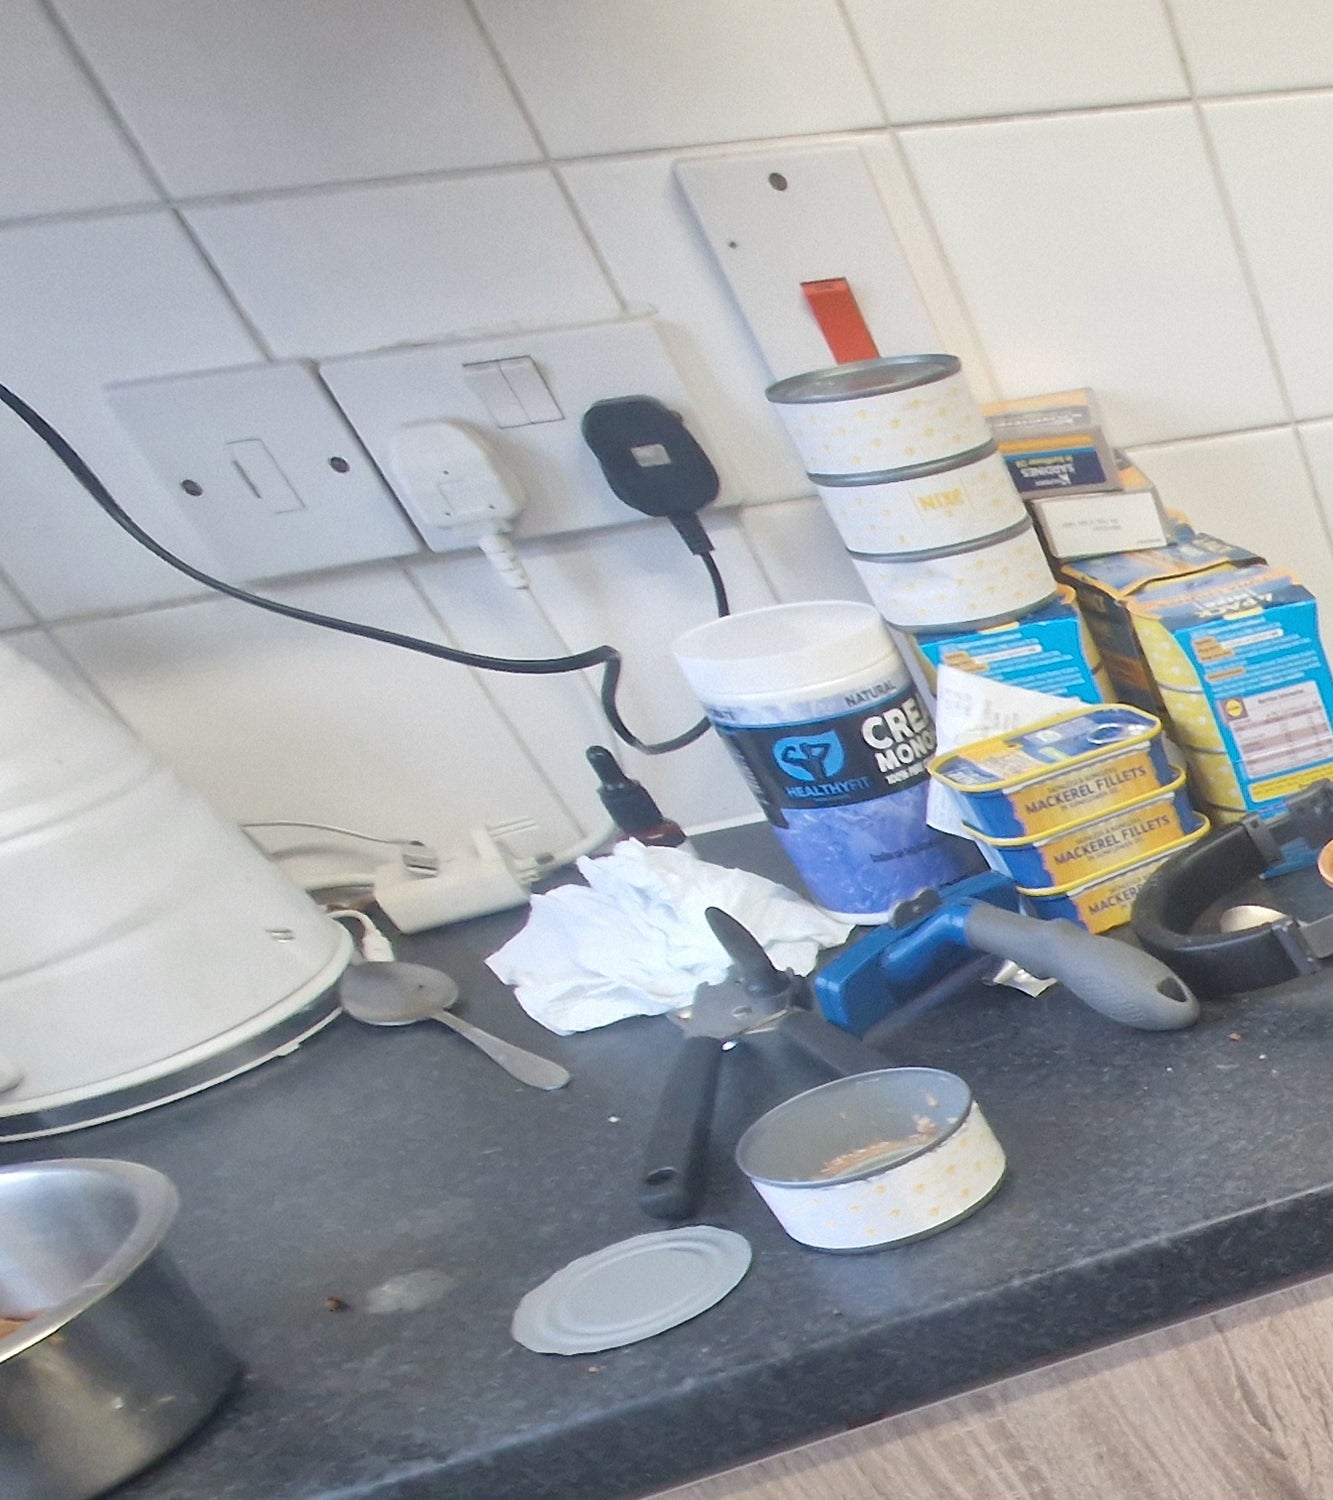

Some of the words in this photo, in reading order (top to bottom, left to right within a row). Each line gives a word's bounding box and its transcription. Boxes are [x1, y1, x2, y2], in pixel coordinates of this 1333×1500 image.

[845, 680, 896, 707] NATURAL
[785, 777, 870, 799] HEALTHYFIT
[1026, 782, 1096, 815] MACKEREL
[1097, 766, 1147, 790] FILLETS
[1054, 833, 1119, 865] MACKEREL
[1121, 815, 1170, 840] FILLETS
[1088, 884, 1143, 915] MACKER
